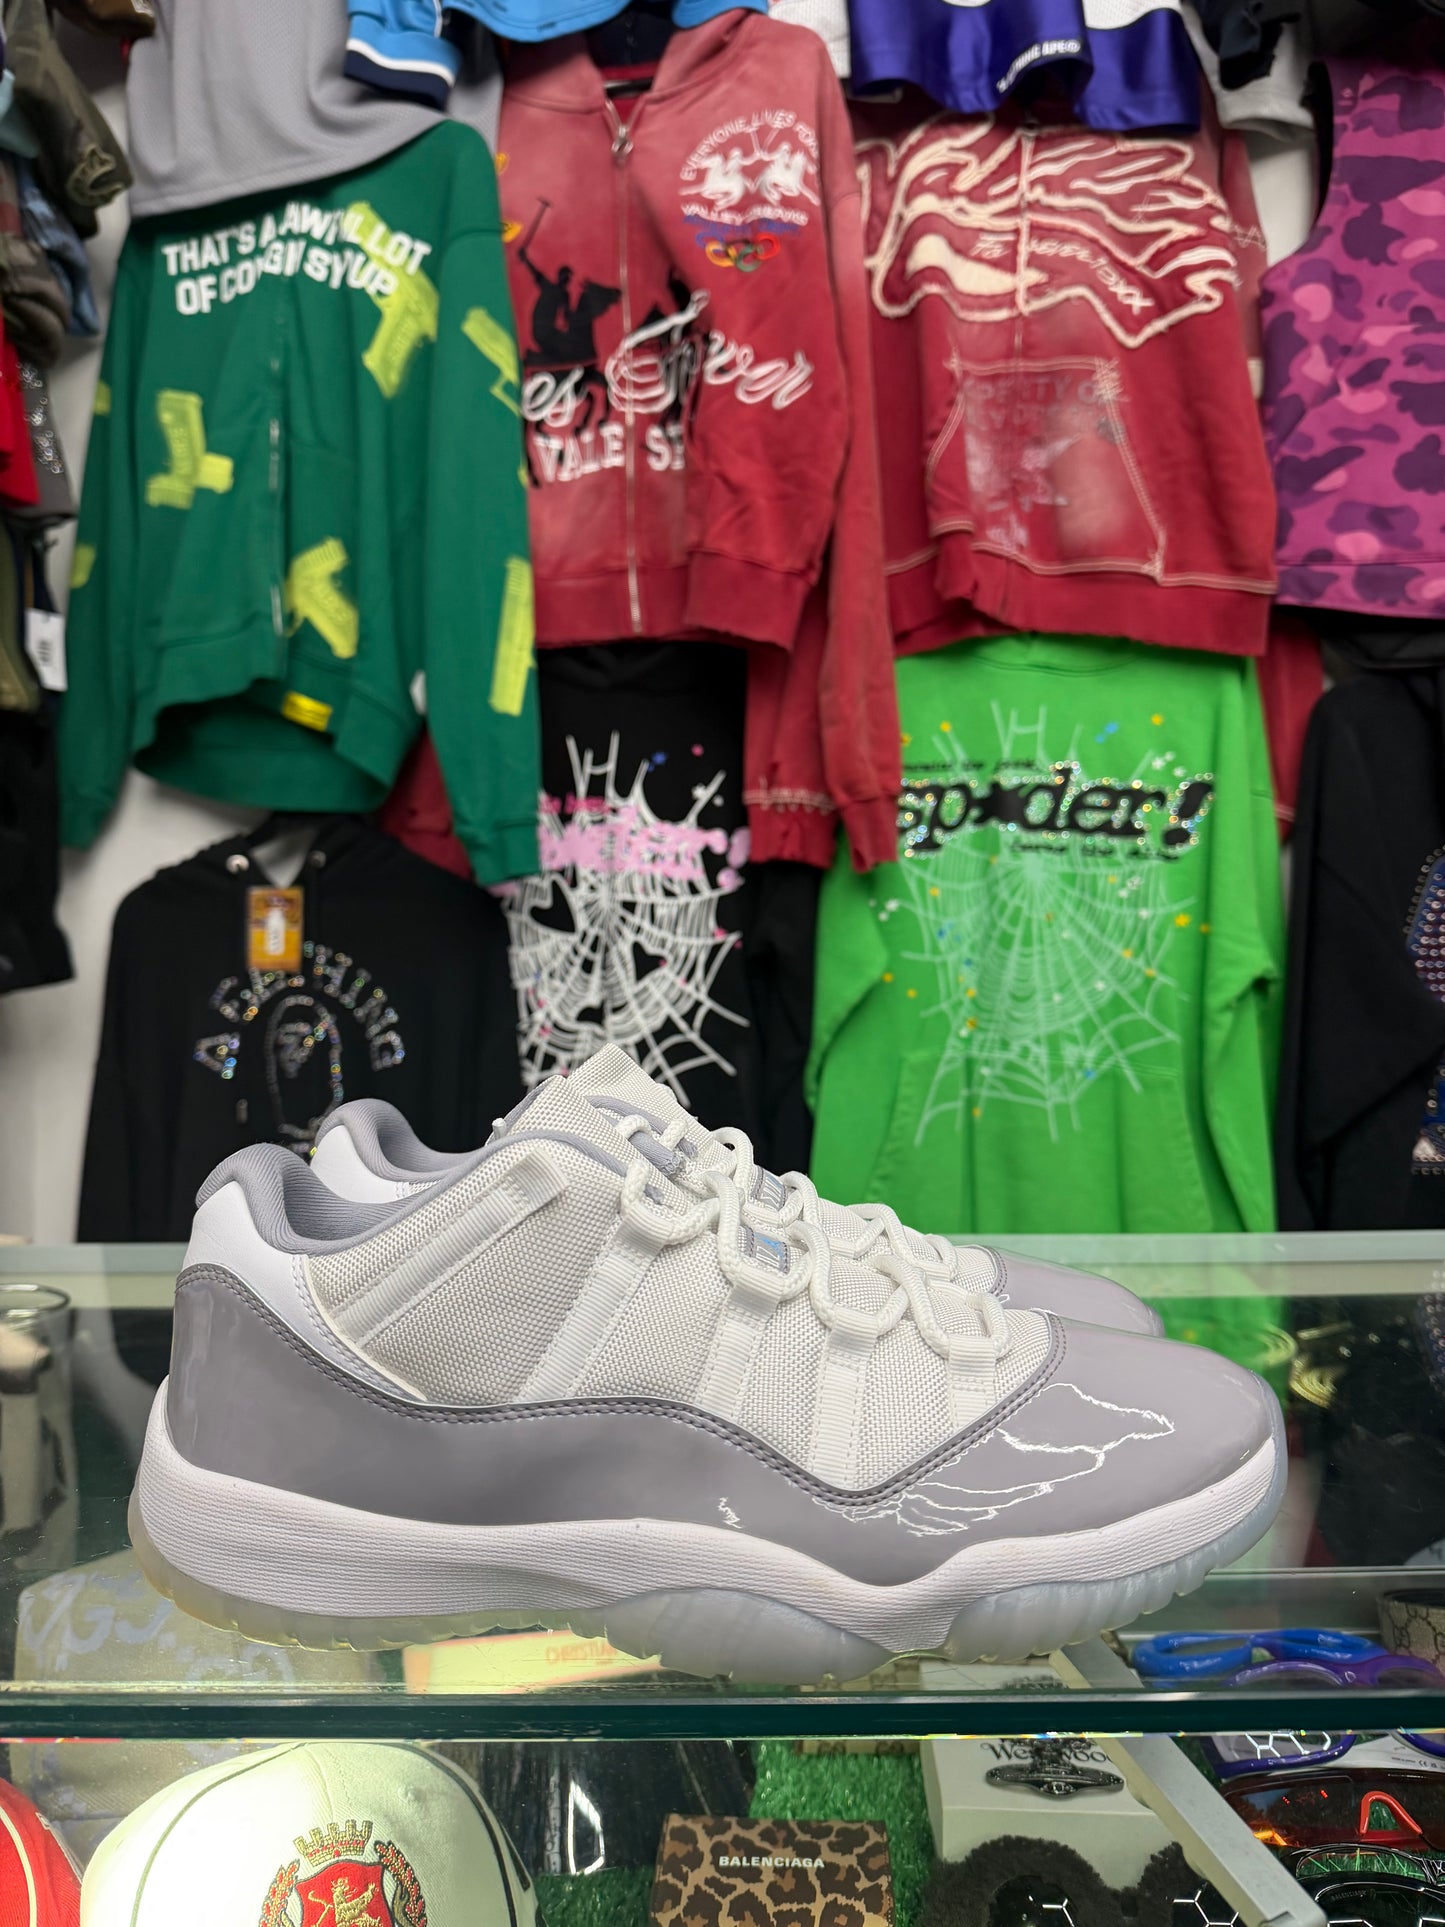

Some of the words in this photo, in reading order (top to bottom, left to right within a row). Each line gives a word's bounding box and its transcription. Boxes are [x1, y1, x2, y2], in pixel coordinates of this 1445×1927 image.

[161, 220, 256, 276] THAT'S
[259, 212, 277, 249] A
[364, 222, 432, 275] LOT
[175, 273, 217, 315] OF
[719, 1856, 825, 1868] BALENCIAGA
